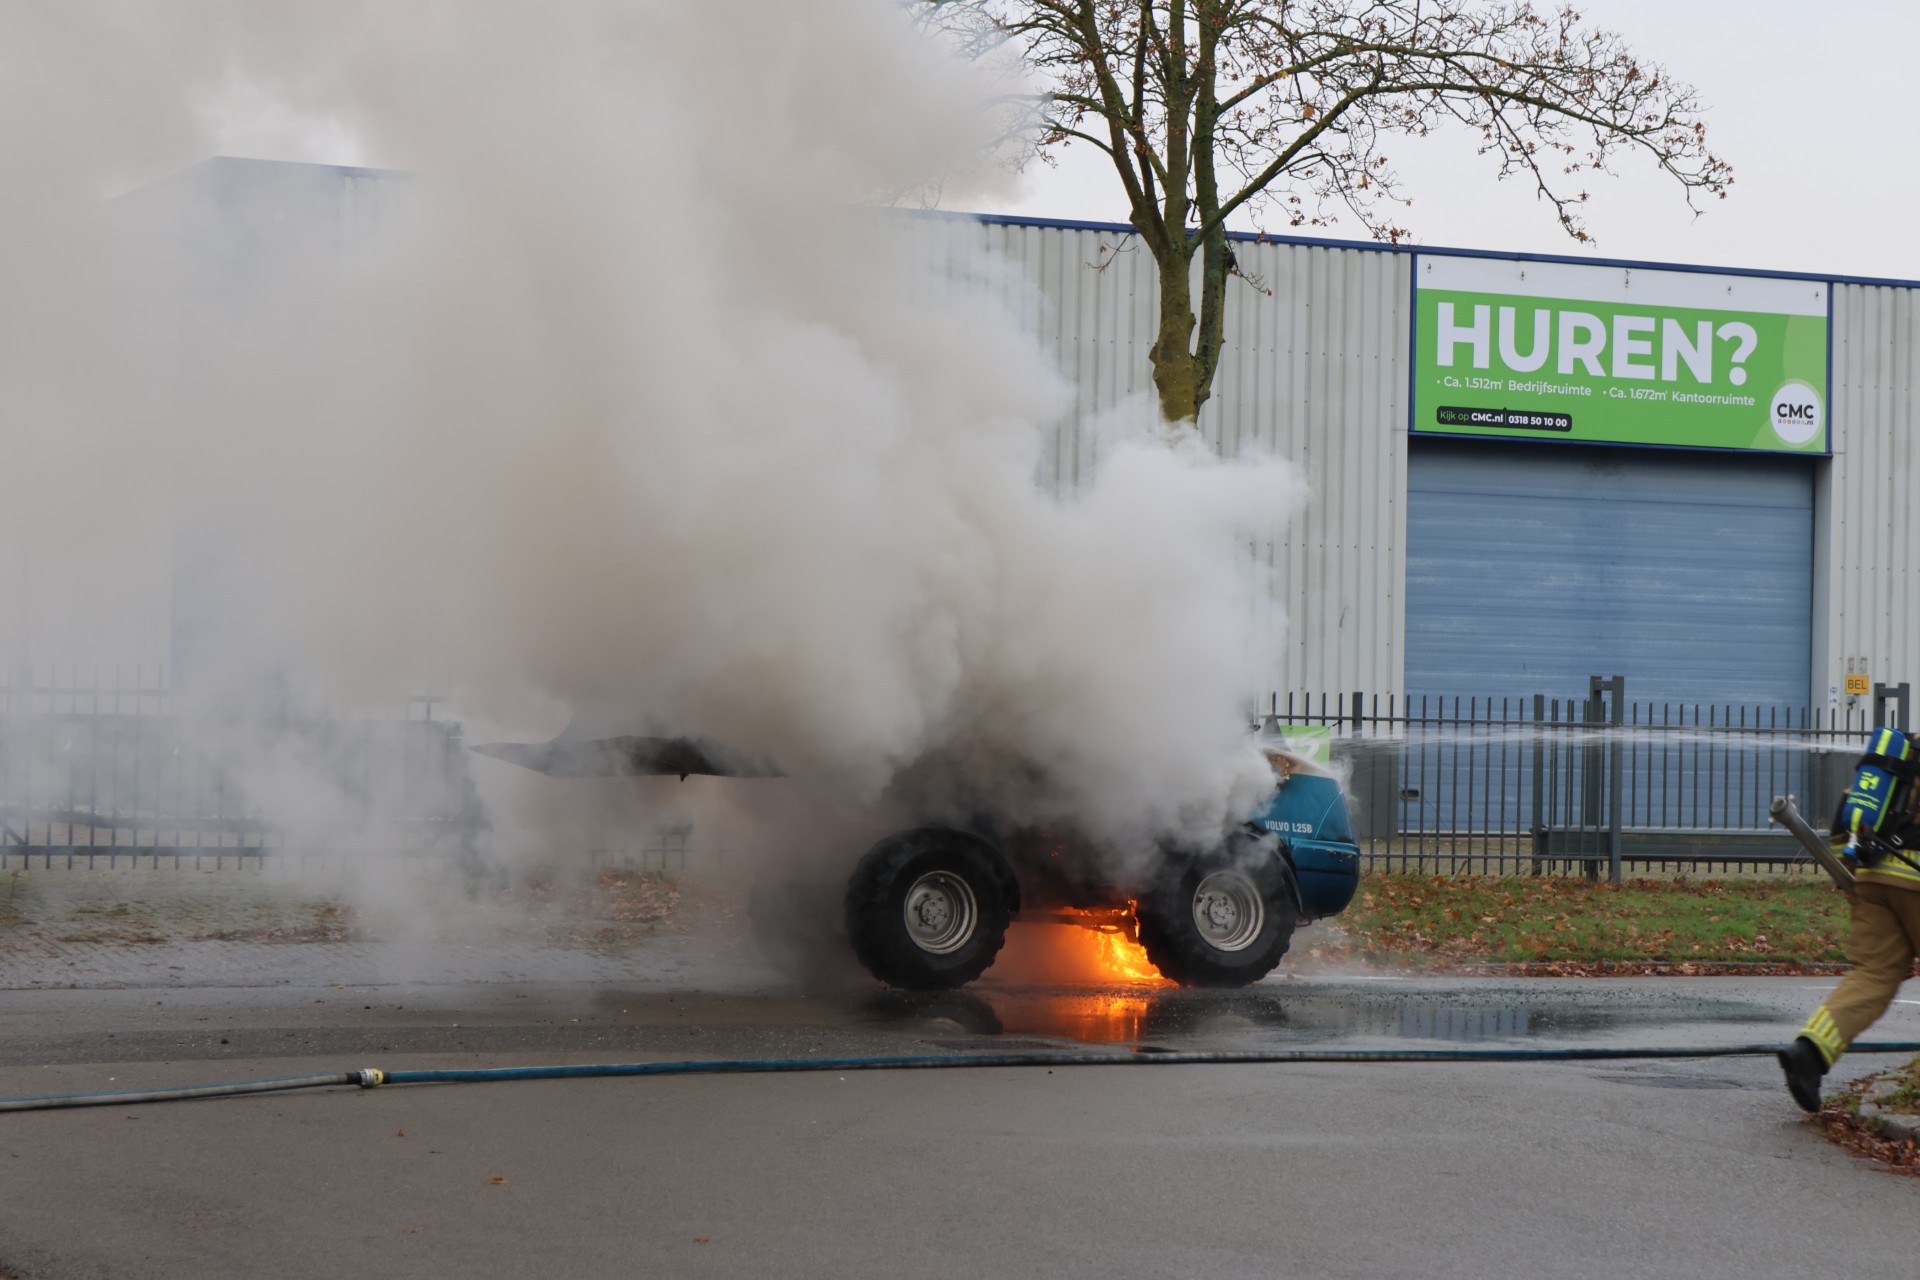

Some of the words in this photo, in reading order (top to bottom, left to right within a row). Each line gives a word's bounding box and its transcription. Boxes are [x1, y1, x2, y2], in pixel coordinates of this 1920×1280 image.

[1436, 302, 1758, 386] HUREN?
[1443, 376, 1462, 388] Ca.
[1508, 380, 1592, 396] Bedrijfsruimte
[1609, 387, 1627, 399] Ca.
[1672, 391, 1755, 406] Kantoorruimte
[1440, 411, 1456, 422] Kijk
[1458, 413, 1469, 422] op
[1471, 412, 1504, 423] CMC.nl
[1776, 403, 1814, 419] CMC
[1508, 414, 1529, 425] 0318
[1530, 416, 1542, 426] 50
[1544, 417, 1554, 426] 10
[1555, 417, 1567, 427] 00
[1847, 679, 1867, 690] BEL
[1265, 820, 1290, 832] VOLVO
[1292, 822, 1313, 834] L25B
